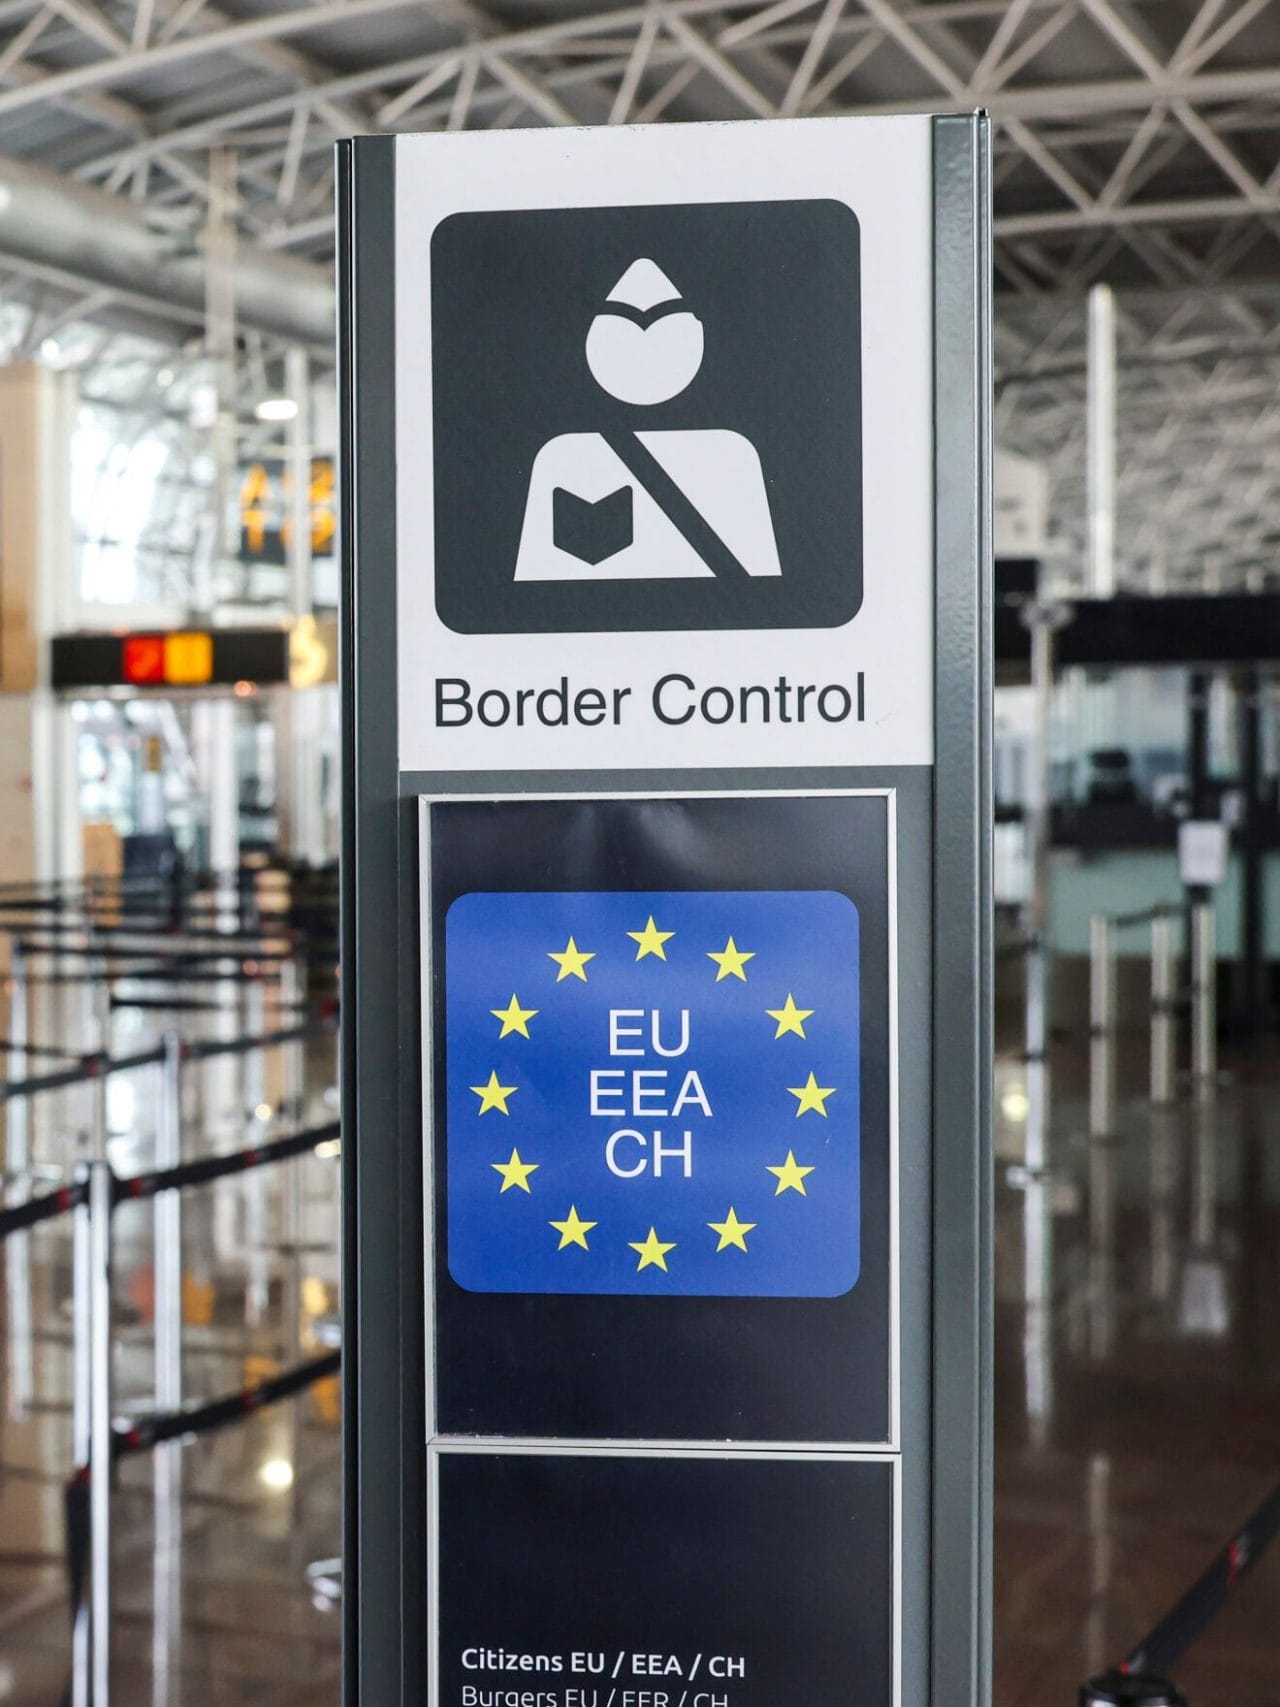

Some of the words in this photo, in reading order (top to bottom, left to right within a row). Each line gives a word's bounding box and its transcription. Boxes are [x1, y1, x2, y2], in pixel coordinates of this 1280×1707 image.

[434, 676, 632, 728] Border
[651, 671, 866, 726] Control
[609, 1009, 690, 1058] EU
[590, 1070, 713, 1117] EEA
[605, 1129, 692, 1178] CH
[461, 1647, 564, 1672] Citizens
[570, 1651, 605, 1674] EU
[611, 1651, 625, 1679] /
[631, 1653, 683, 1676] EEA
[688, 1653, 702, 1681] /
[708, 1655, 745, 1678] CH
[462, 1685, 558, 1707] Burgers
[565, 1688, 597, 1707] EU
